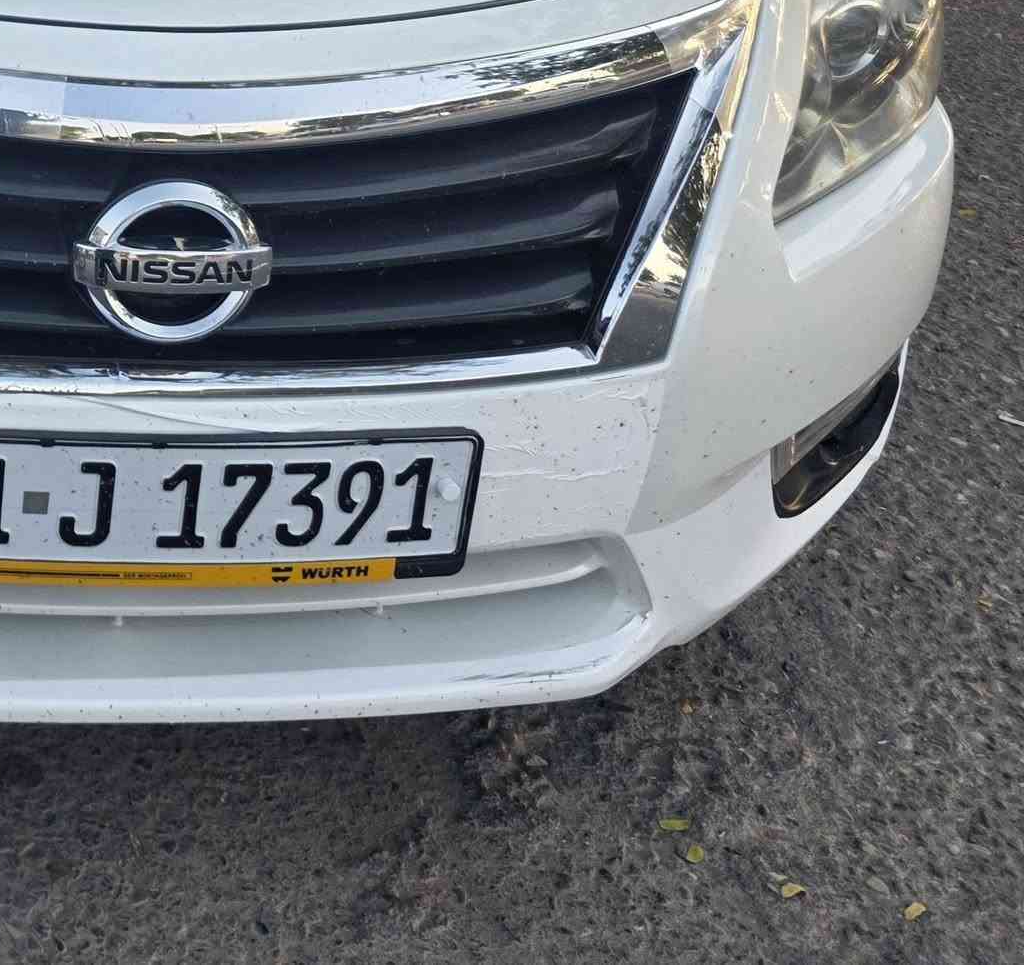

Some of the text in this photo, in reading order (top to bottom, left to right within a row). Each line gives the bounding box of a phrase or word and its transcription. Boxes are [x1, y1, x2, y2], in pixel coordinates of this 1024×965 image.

[97, 254, 253, 284] NISSAN
[58, 462, 116, 548] J
[156, 457, 434, 548] 17391
